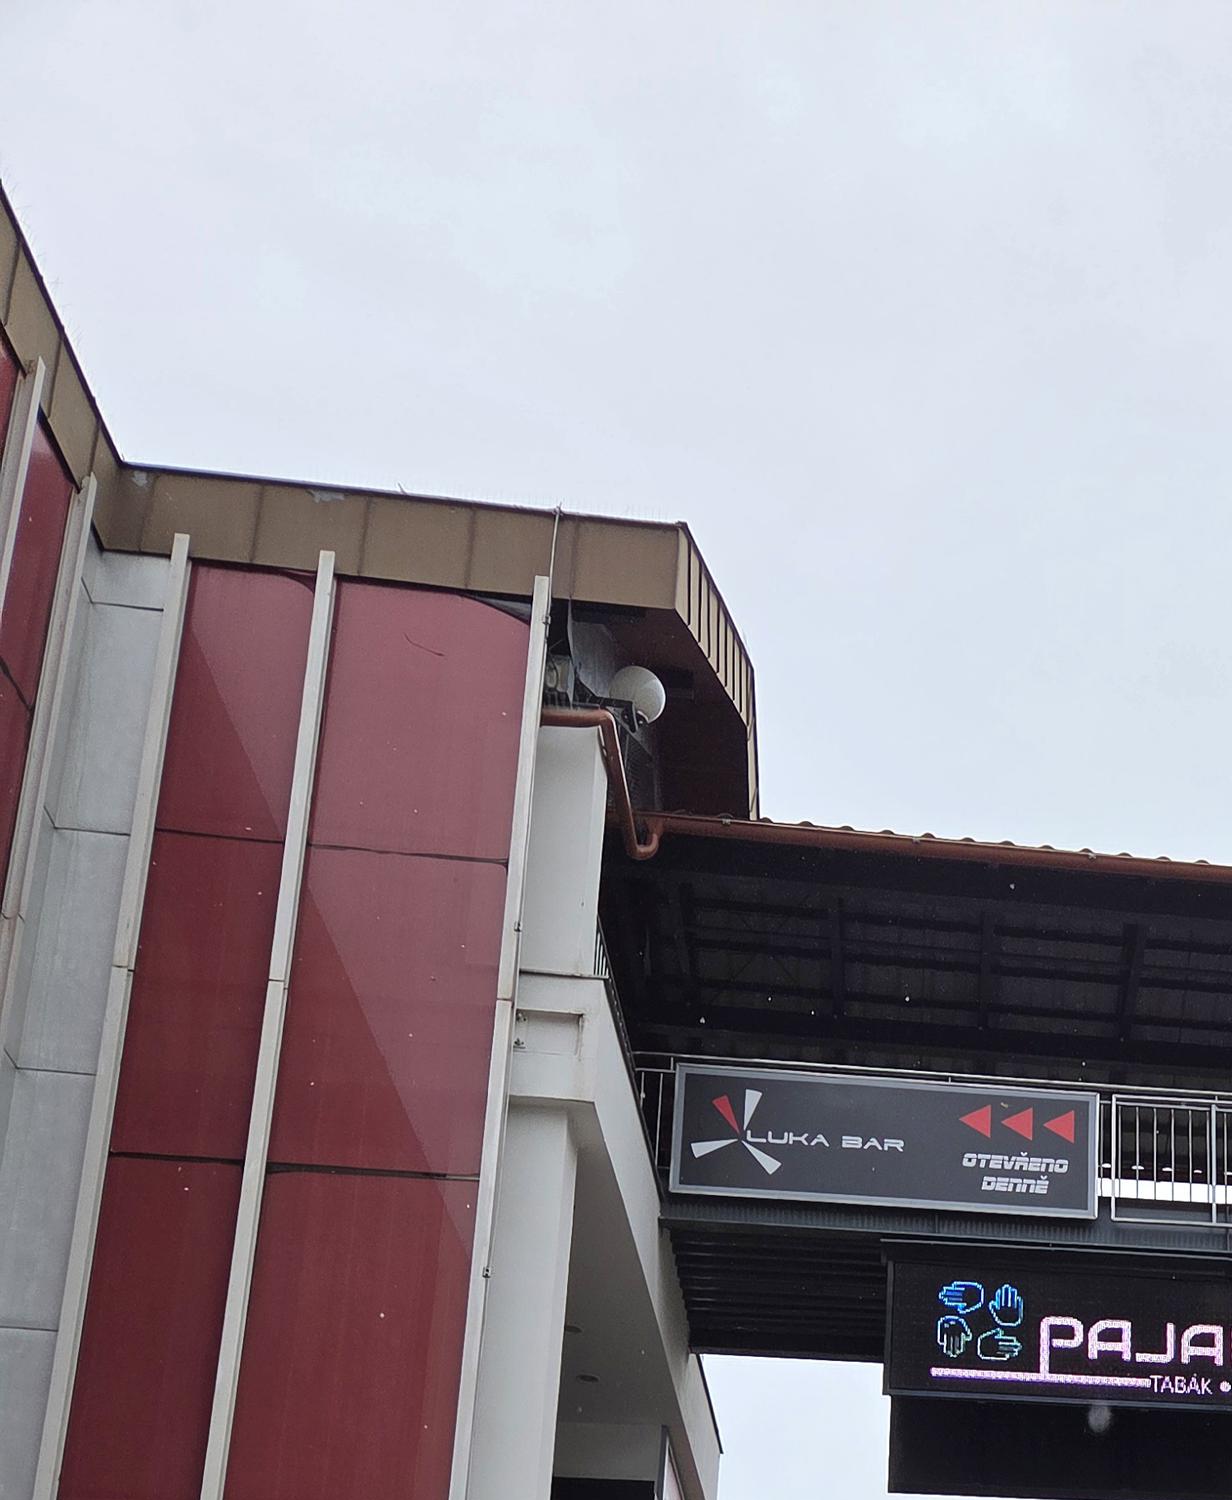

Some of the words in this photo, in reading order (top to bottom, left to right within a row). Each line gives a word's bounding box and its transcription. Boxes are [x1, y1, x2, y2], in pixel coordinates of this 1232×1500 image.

[746, 1131, 829, 1147] LUKA
[842, 1137, 904, 1152] BAR
[963, 1152, 1069, 1174] OTEVŘENO
[982, 1176, 1049, 1194] DENNĚ
[1150, 1373, 1213, 1396] TABÁK
